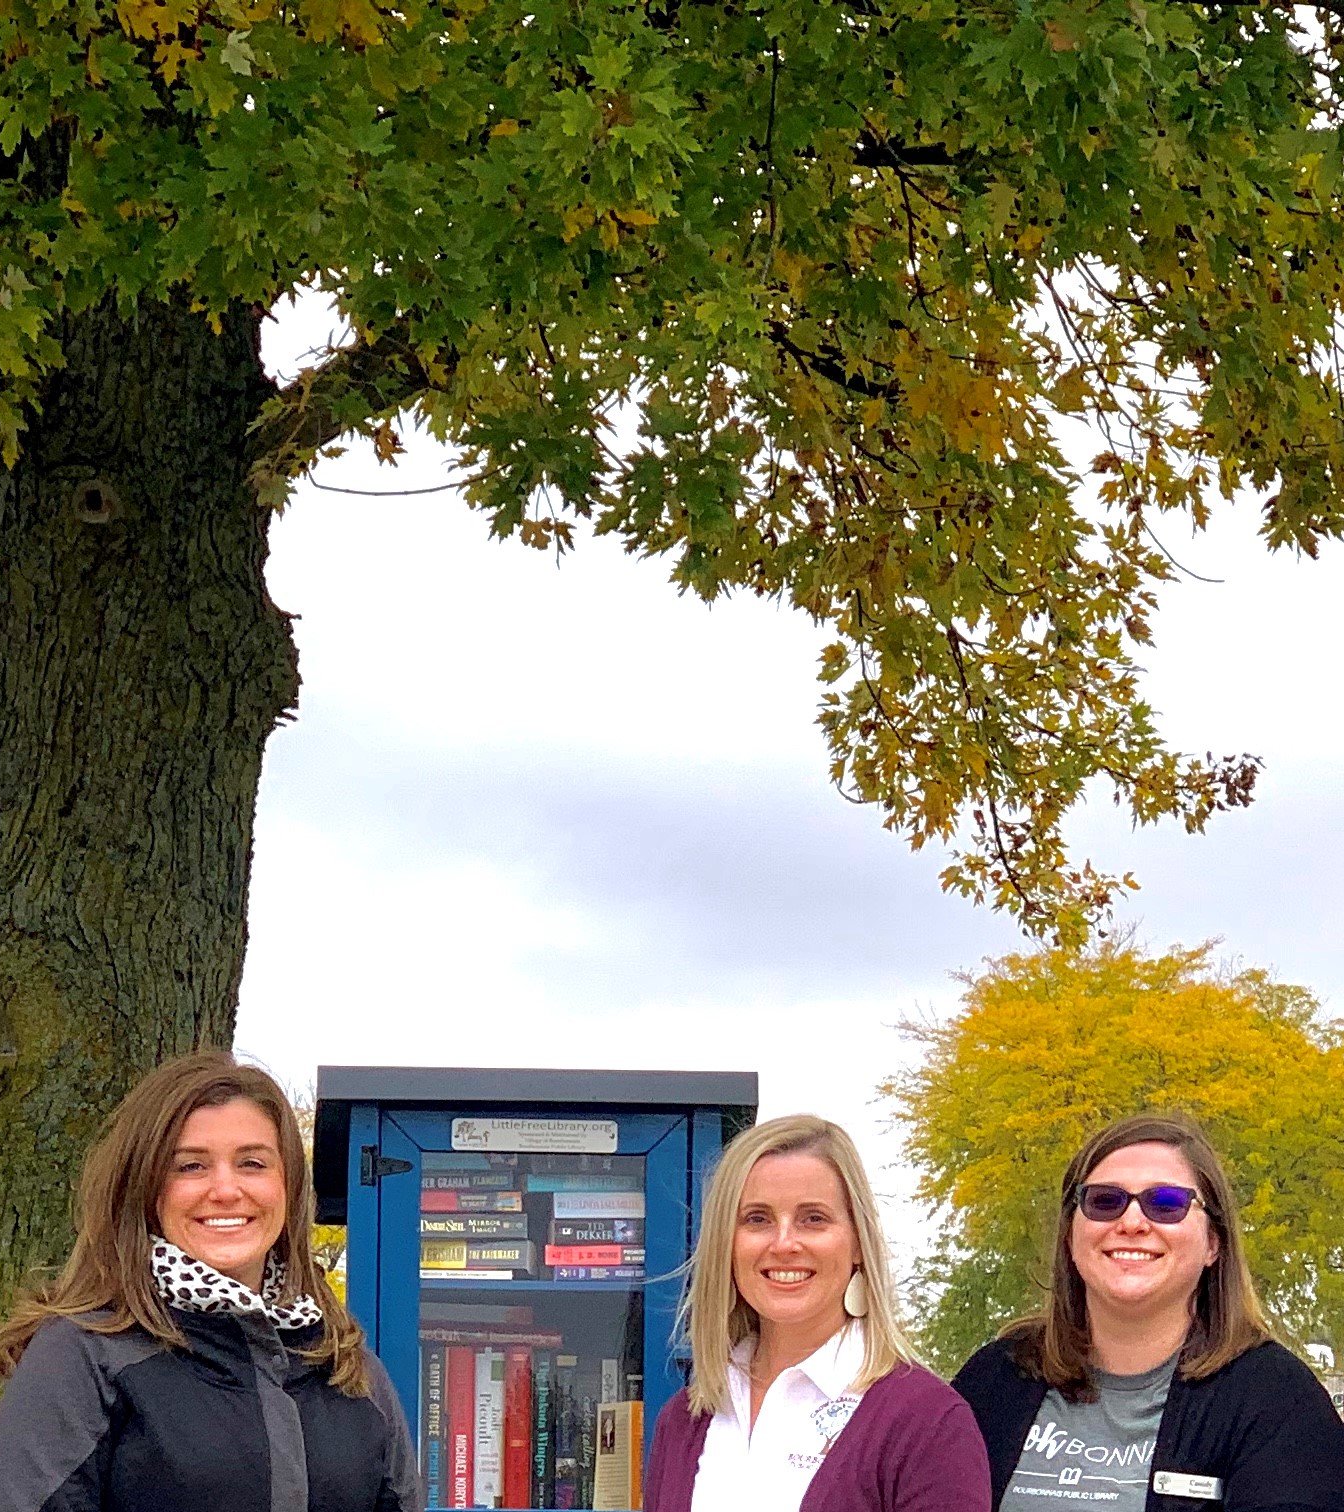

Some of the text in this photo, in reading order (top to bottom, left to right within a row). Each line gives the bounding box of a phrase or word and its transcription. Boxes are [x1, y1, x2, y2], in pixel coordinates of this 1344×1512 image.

[491, 1120, 612, 1133] LittleFreeLibrary.org
[438, 1177, 470, 1188] GRAHAM
[576, 1230, 614, 1240] DEKKER
[469, 1250, 480, 1260] THE
[481, 1249, 520, 1260] RAINMAKER
[429, 1363, 440, 1387] OATH
[429, 1389, 440, 1400] OF
[428, 1403, 440, 1436] OFFICE
[479, 1393, 492, 1444] Picoult
[535, 1361, 549, 1477] The Dakota Winters
[456, 1434, 467, 1476] MICHAEL
[1013, 1486, 1119, 1500] BOURBONNAIS PUBLIC LIBRARY
